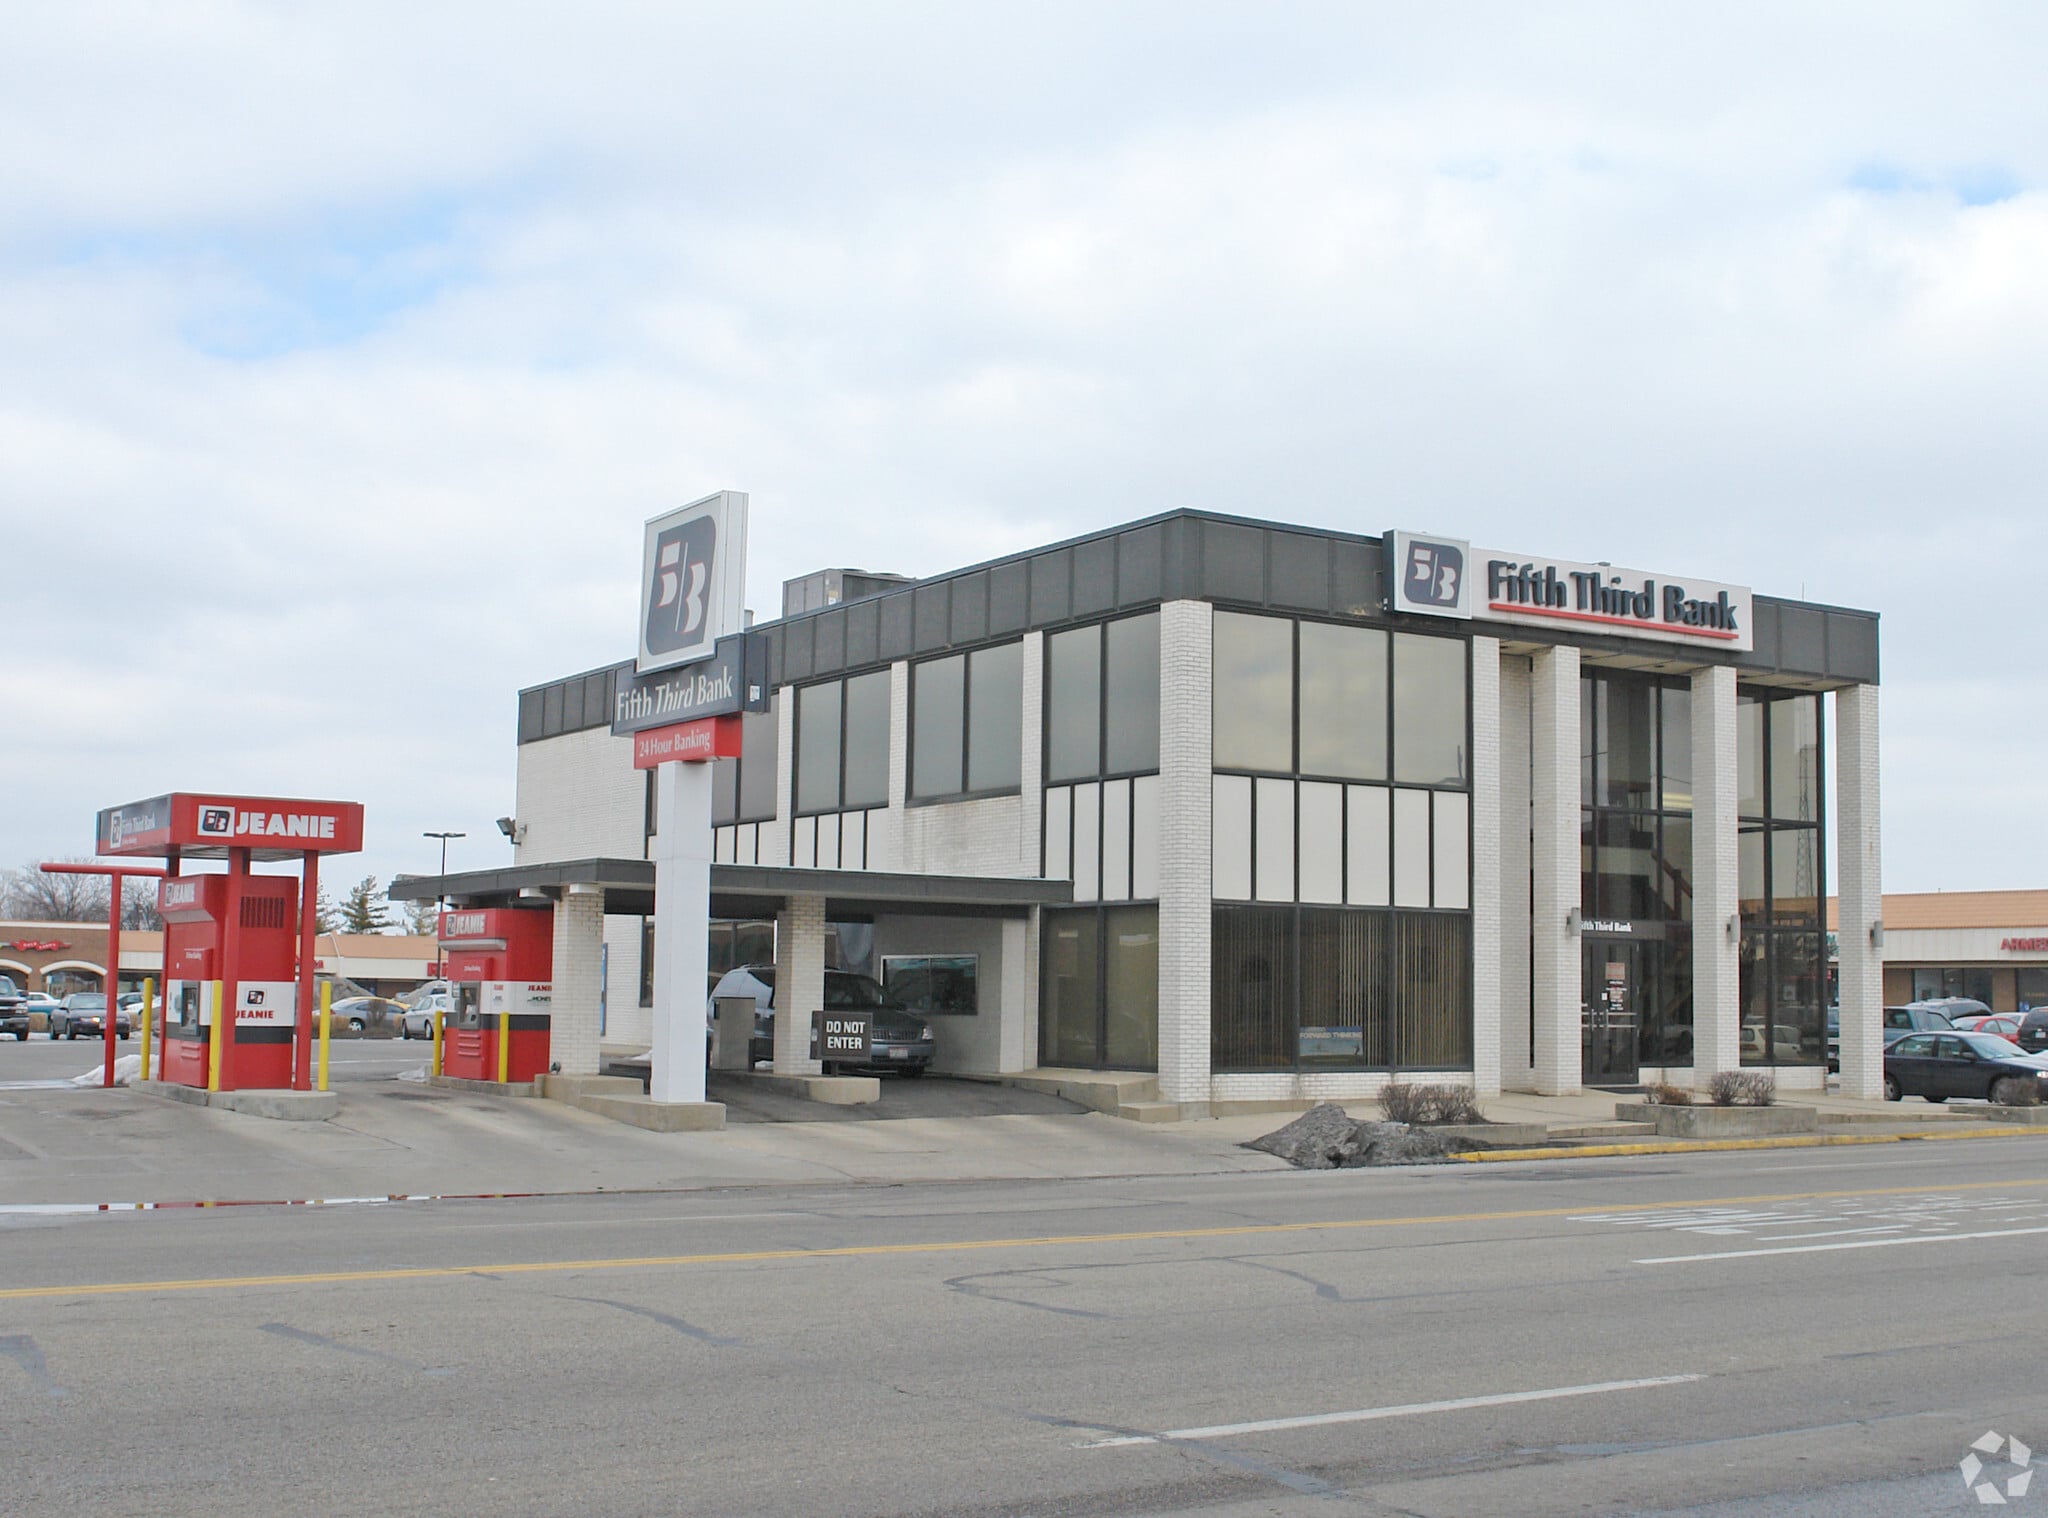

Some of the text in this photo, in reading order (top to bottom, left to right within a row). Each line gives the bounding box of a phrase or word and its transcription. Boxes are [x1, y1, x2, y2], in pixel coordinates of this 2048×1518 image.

[1488, 560, 1738, 629] Fifth Third Bank
[616, 665, 733, 721] Fifth Third Bank
[639, 728, 710, 757] 24 Hour Banking
[235, 811, 336, 839] JEANIE
[455, 914, 486, 935] JEANIE
[1595, 920, 1613, 931] Third
[1614, 921, 1632, 933] Bank
[826, 1021, 866, 1034] DO NOT
[827, 1036, 862, 1050] ENTER
